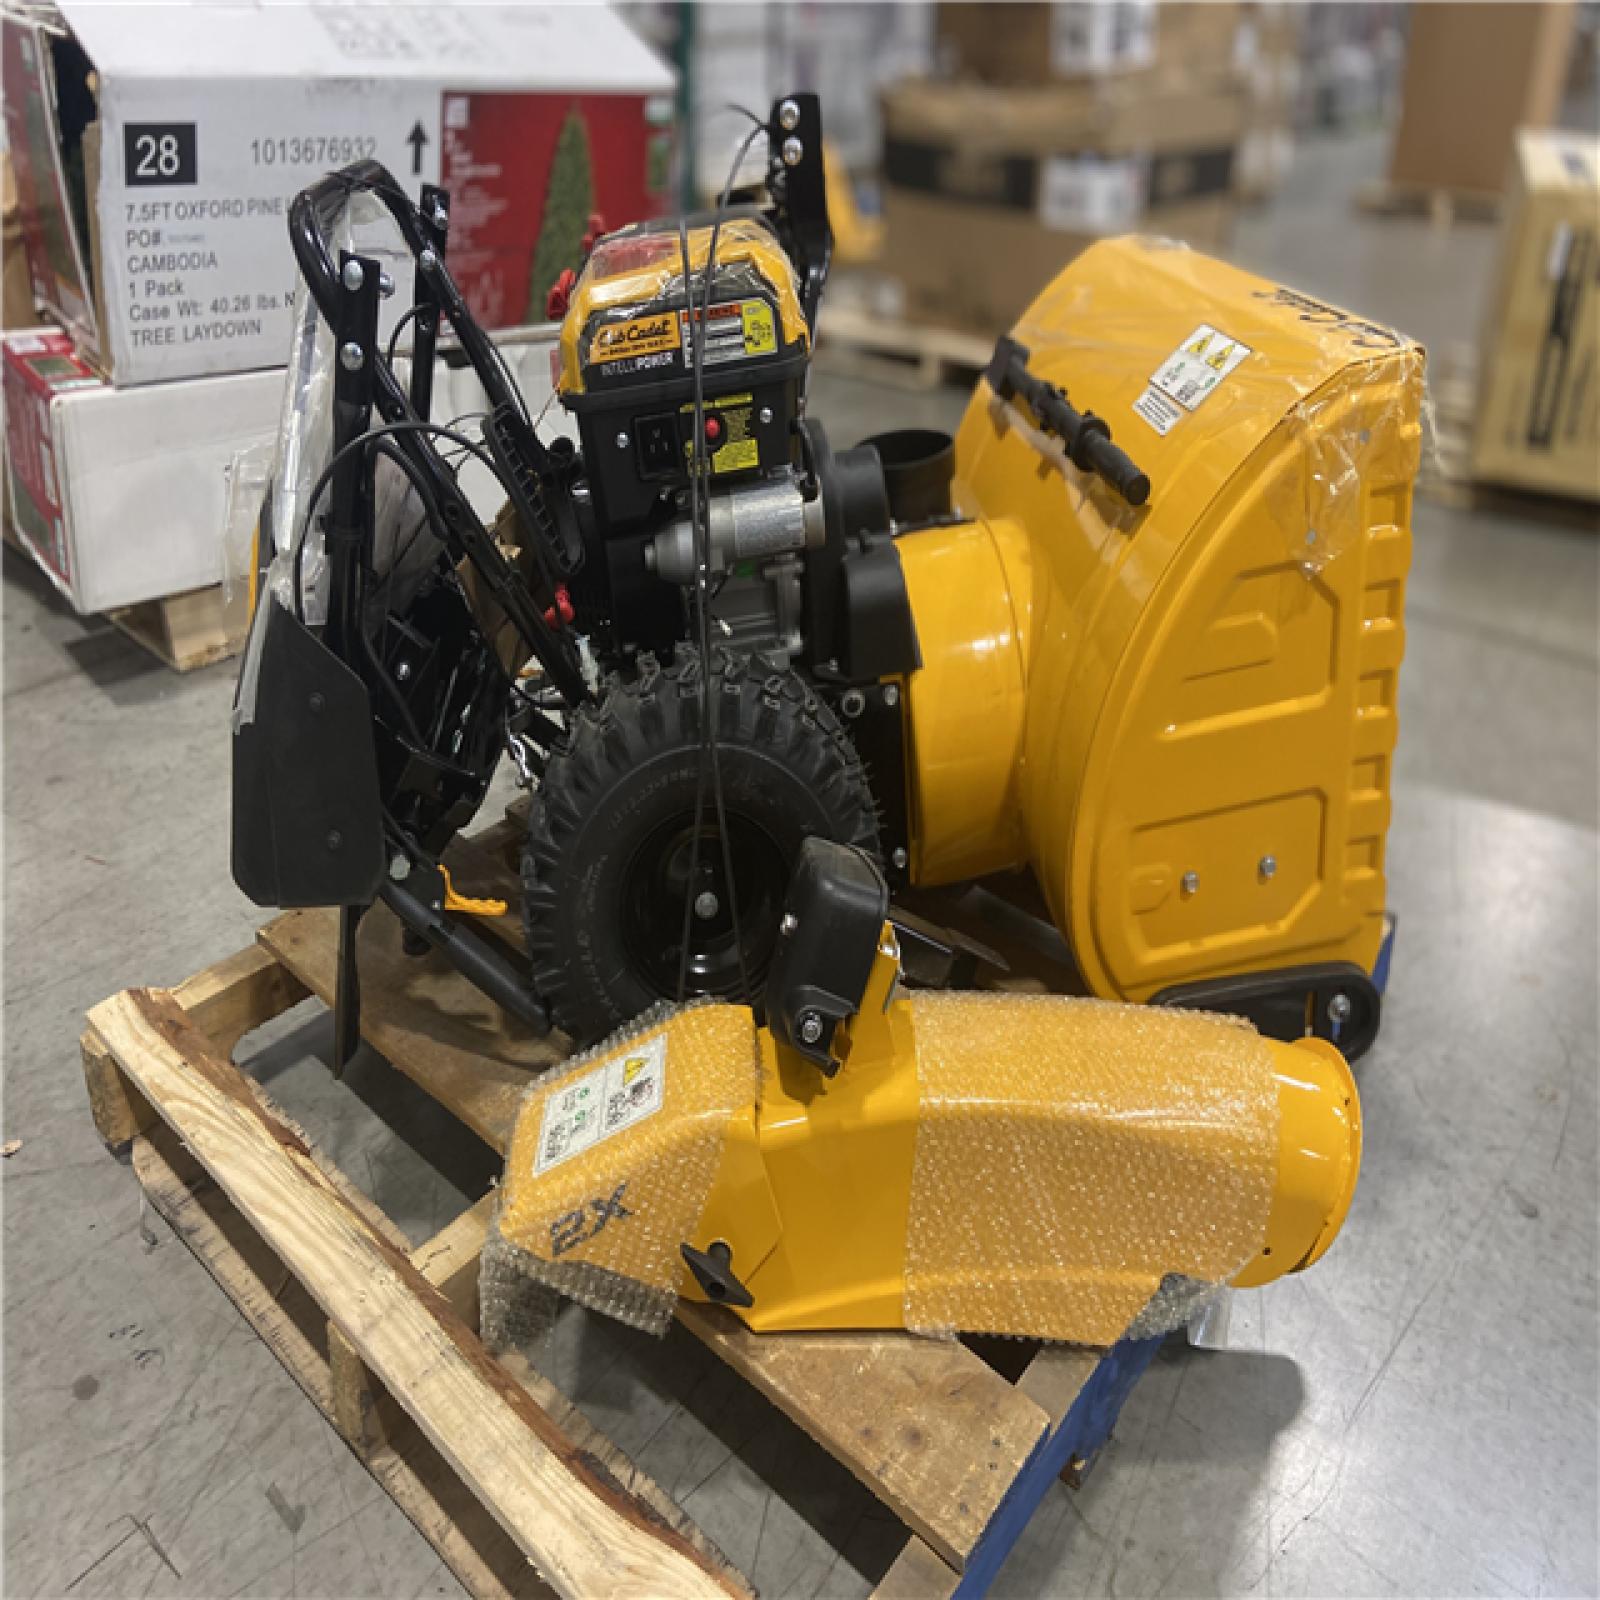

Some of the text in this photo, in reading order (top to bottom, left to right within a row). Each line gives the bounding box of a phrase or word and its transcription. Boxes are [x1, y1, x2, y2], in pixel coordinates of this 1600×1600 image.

[135, 134, 180, 176] 28
[251, 136, 376, 164] 1013676932
[126, 203, 171, 222] 7.5FT
[174, 200, 242, 220] OXFORD
[247, 197, 282, 216] PINE
[127, 229, 161, 247] PO#
[127, 251, 217, 274] CAMBODIA
[129, 277, 183, 298] 1 Pack
[129, 304, 171, 322] Case
[130, 319, 261, 346] TREE LAYDOWN
